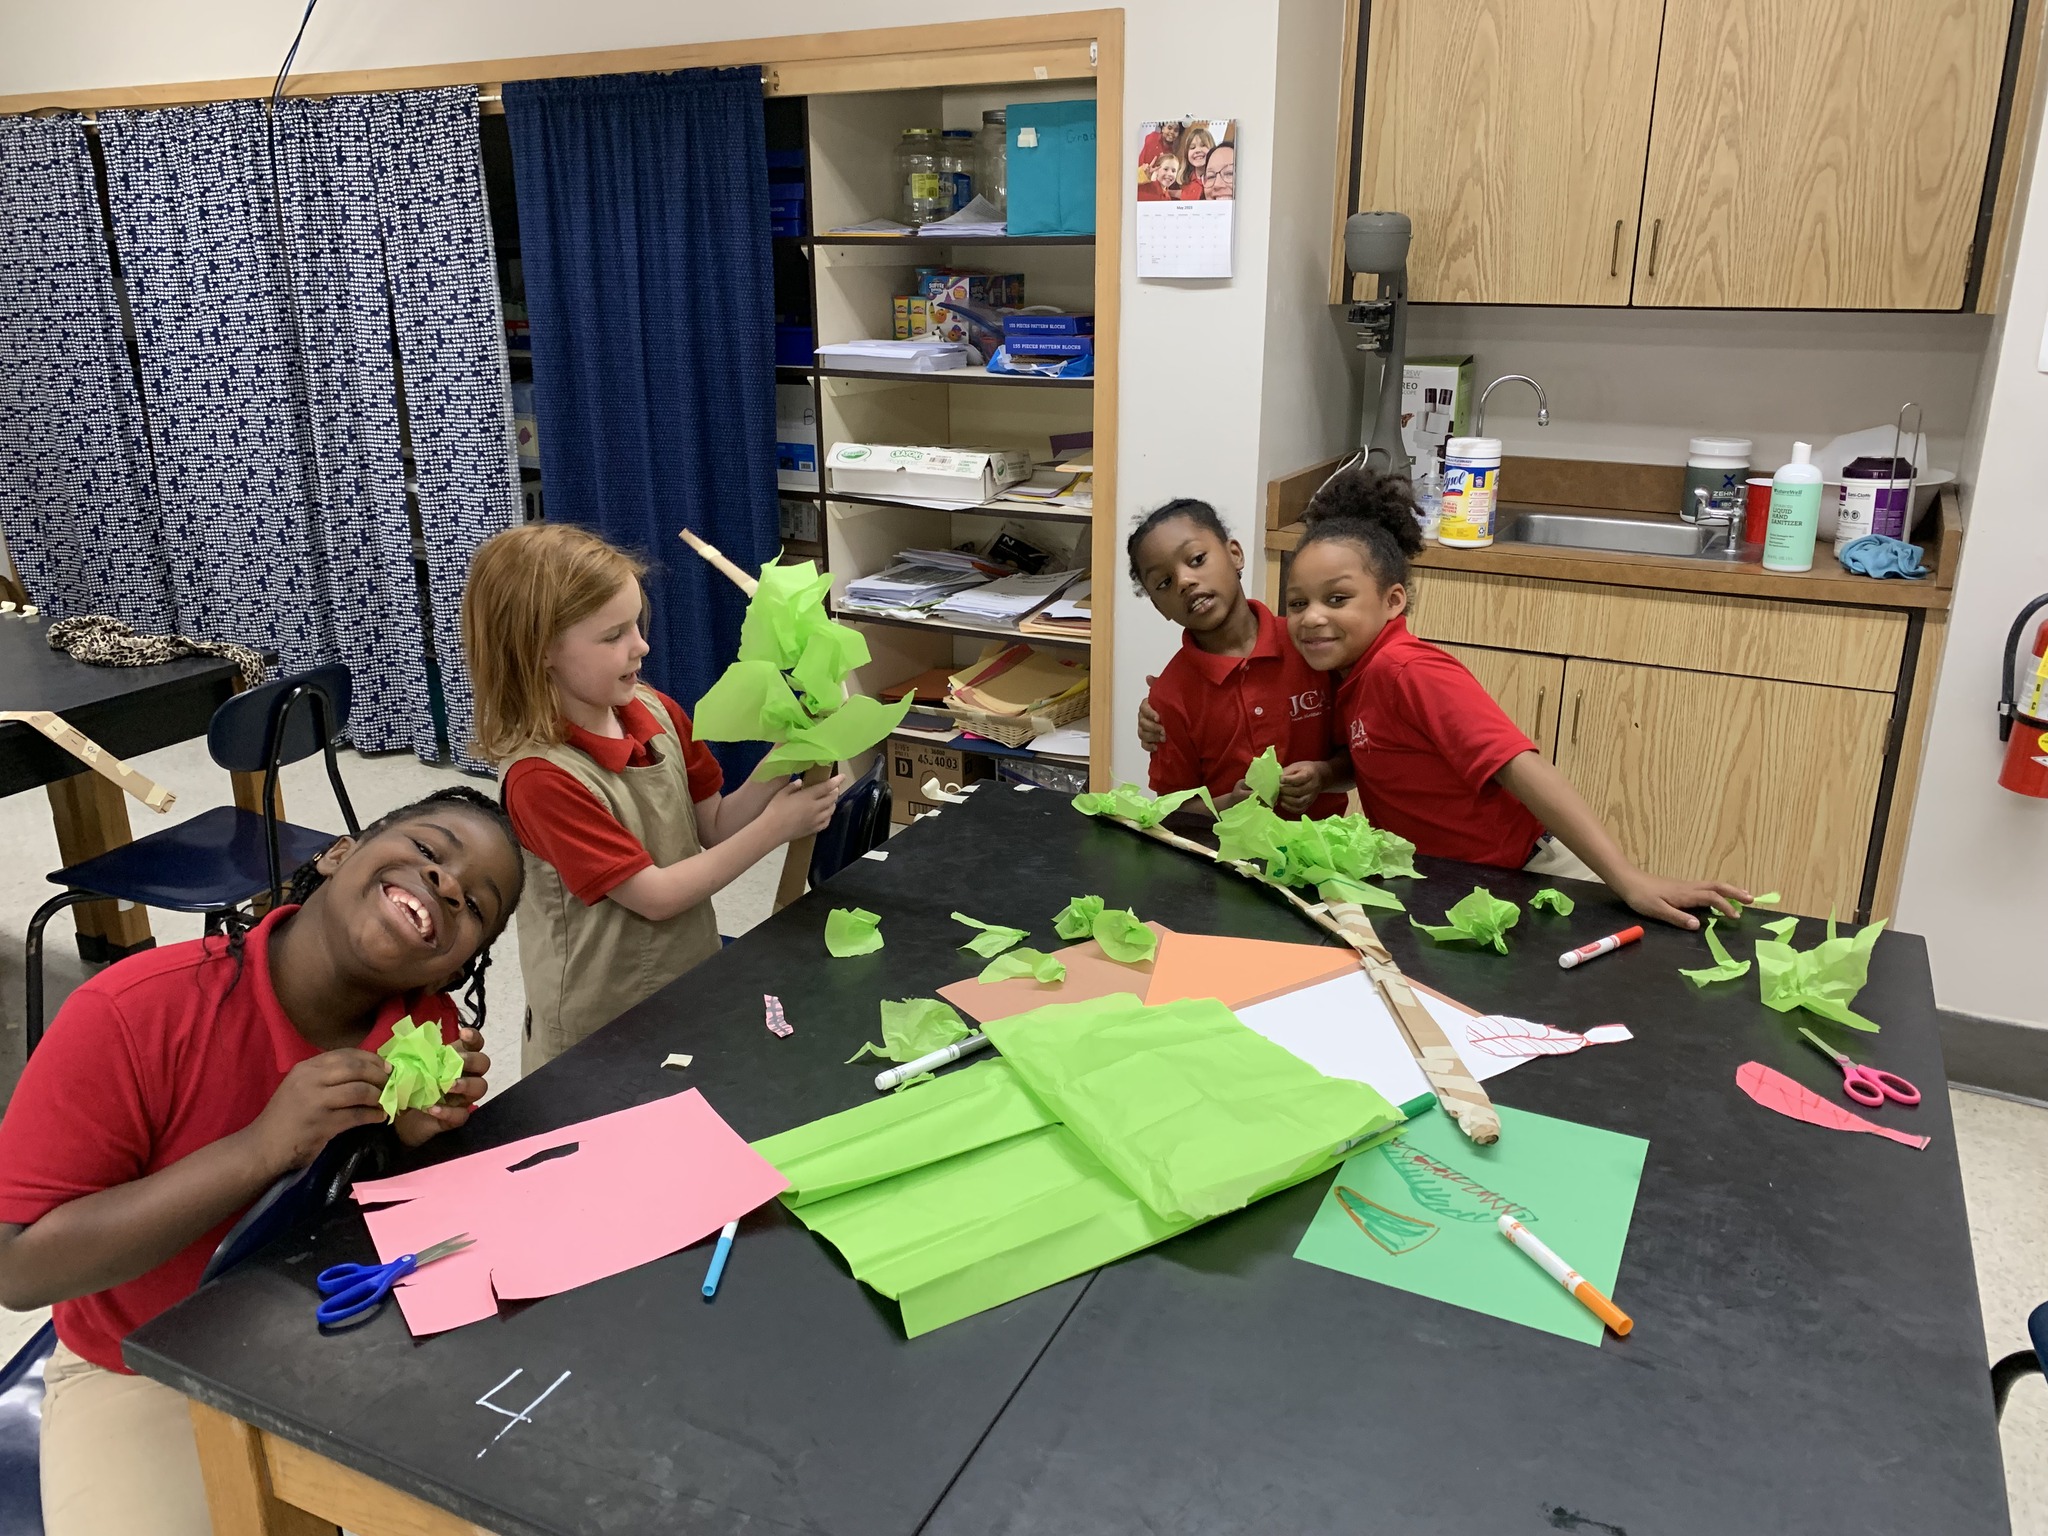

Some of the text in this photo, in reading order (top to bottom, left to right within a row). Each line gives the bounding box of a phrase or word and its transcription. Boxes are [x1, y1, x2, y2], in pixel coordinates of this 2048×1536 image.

[803, 408, 815, 426] B
[890, 450, 924, 460] CRAYONS
[899, 760, 909, 775] D
